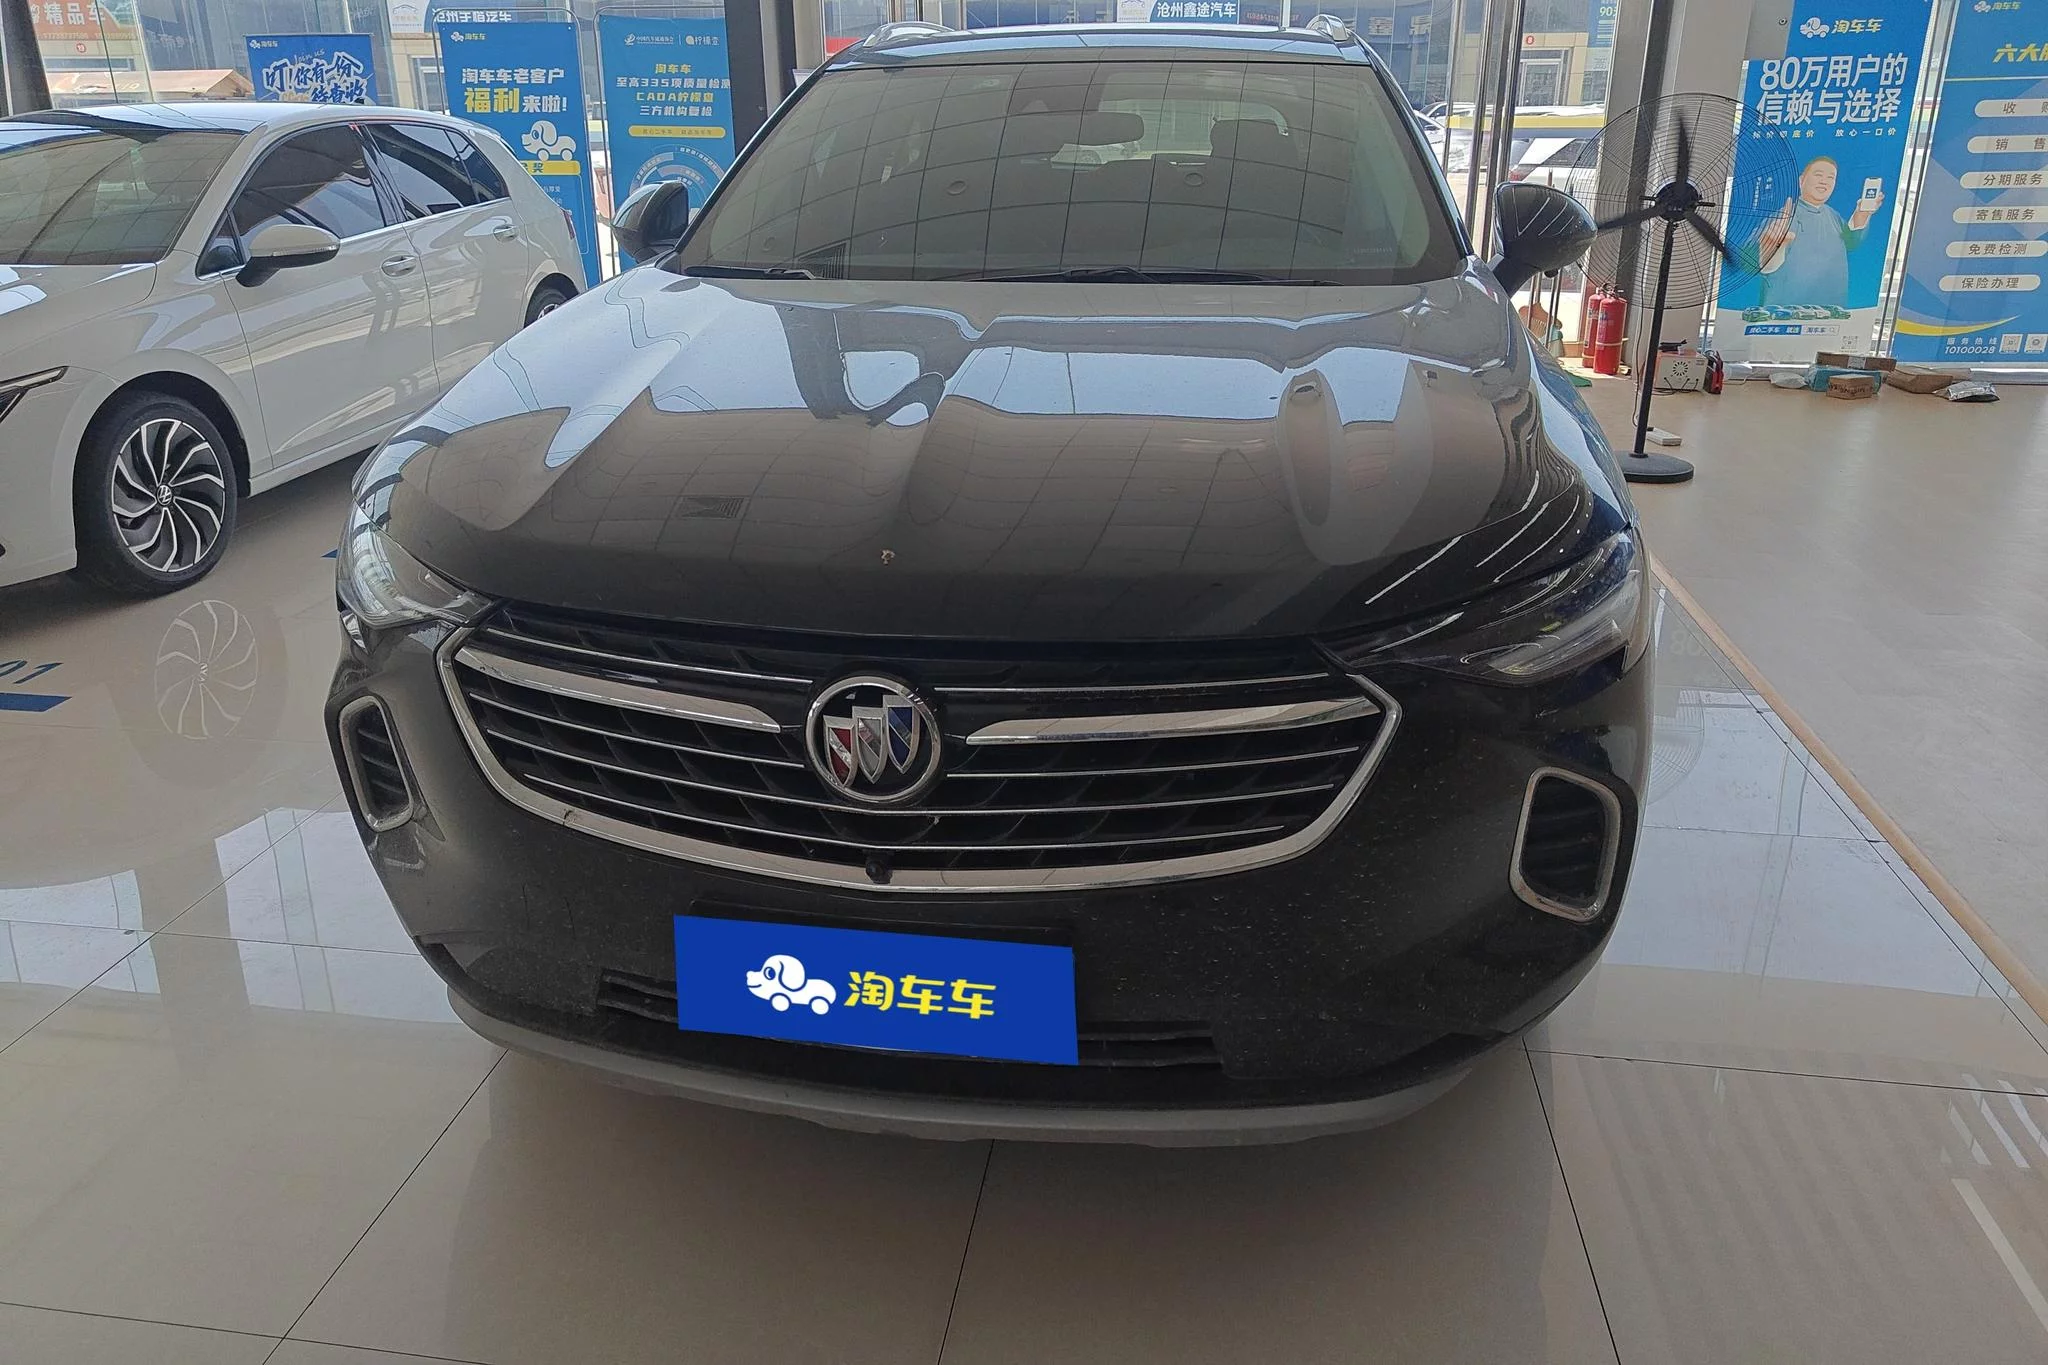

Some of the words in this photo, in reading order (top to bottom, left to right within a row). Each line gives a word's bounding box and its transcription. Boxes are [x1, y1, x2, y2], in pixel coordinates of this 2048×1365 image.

[1157, 2, 1236, 18] 沧州鑫途汽车
[1832, 19, 1883, 33] 淘车车
[655, 63, 692, 74] 淘车车
[1760, 53, 1909, 90] 80万用户的
[462, 67, 565, 84] 淘车车老客户
[1756, 87, 1901, 126] 信赖与选择
[1835, 127, 1897, 137] 放心一口价
[1995, 137, 2046, 151] 销售
[1983, 173, 2043, 186] 分期服务
[1976, 208, 2035, 221] 寄售服务
[1968, 243, 2027, 255] 免费检测
[1961, 277, 2019, 289] 保险办理
[1945, 346, 1997, 354] 10100028
